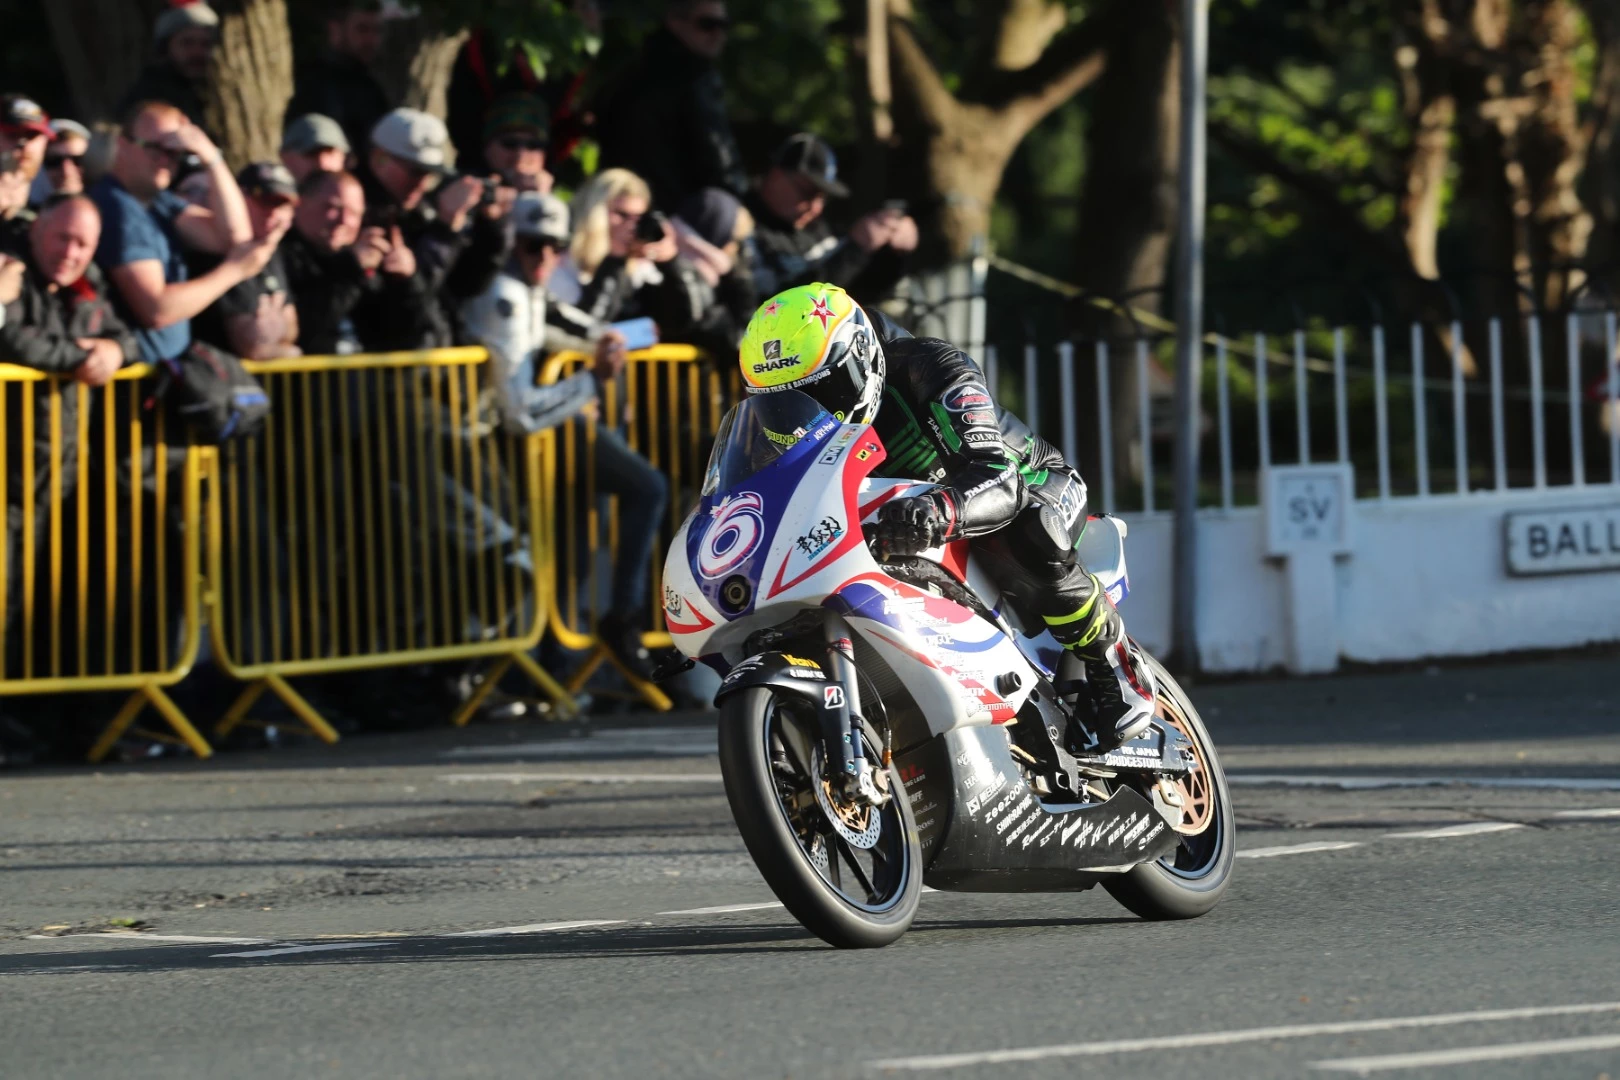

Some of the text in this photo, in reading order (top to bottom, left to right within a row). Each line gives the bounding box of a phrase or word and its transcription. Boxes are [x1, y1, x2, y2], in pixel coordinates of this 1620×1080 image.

[753, 355, 801, 373] SHARK
[793, 368, 831, 389] BATHROOMS
[697, 491, 765, 580] 6
[1527, 520, 1620, 560] BALL
[1104, 753, 1163, 768] BRIDGESTONE
